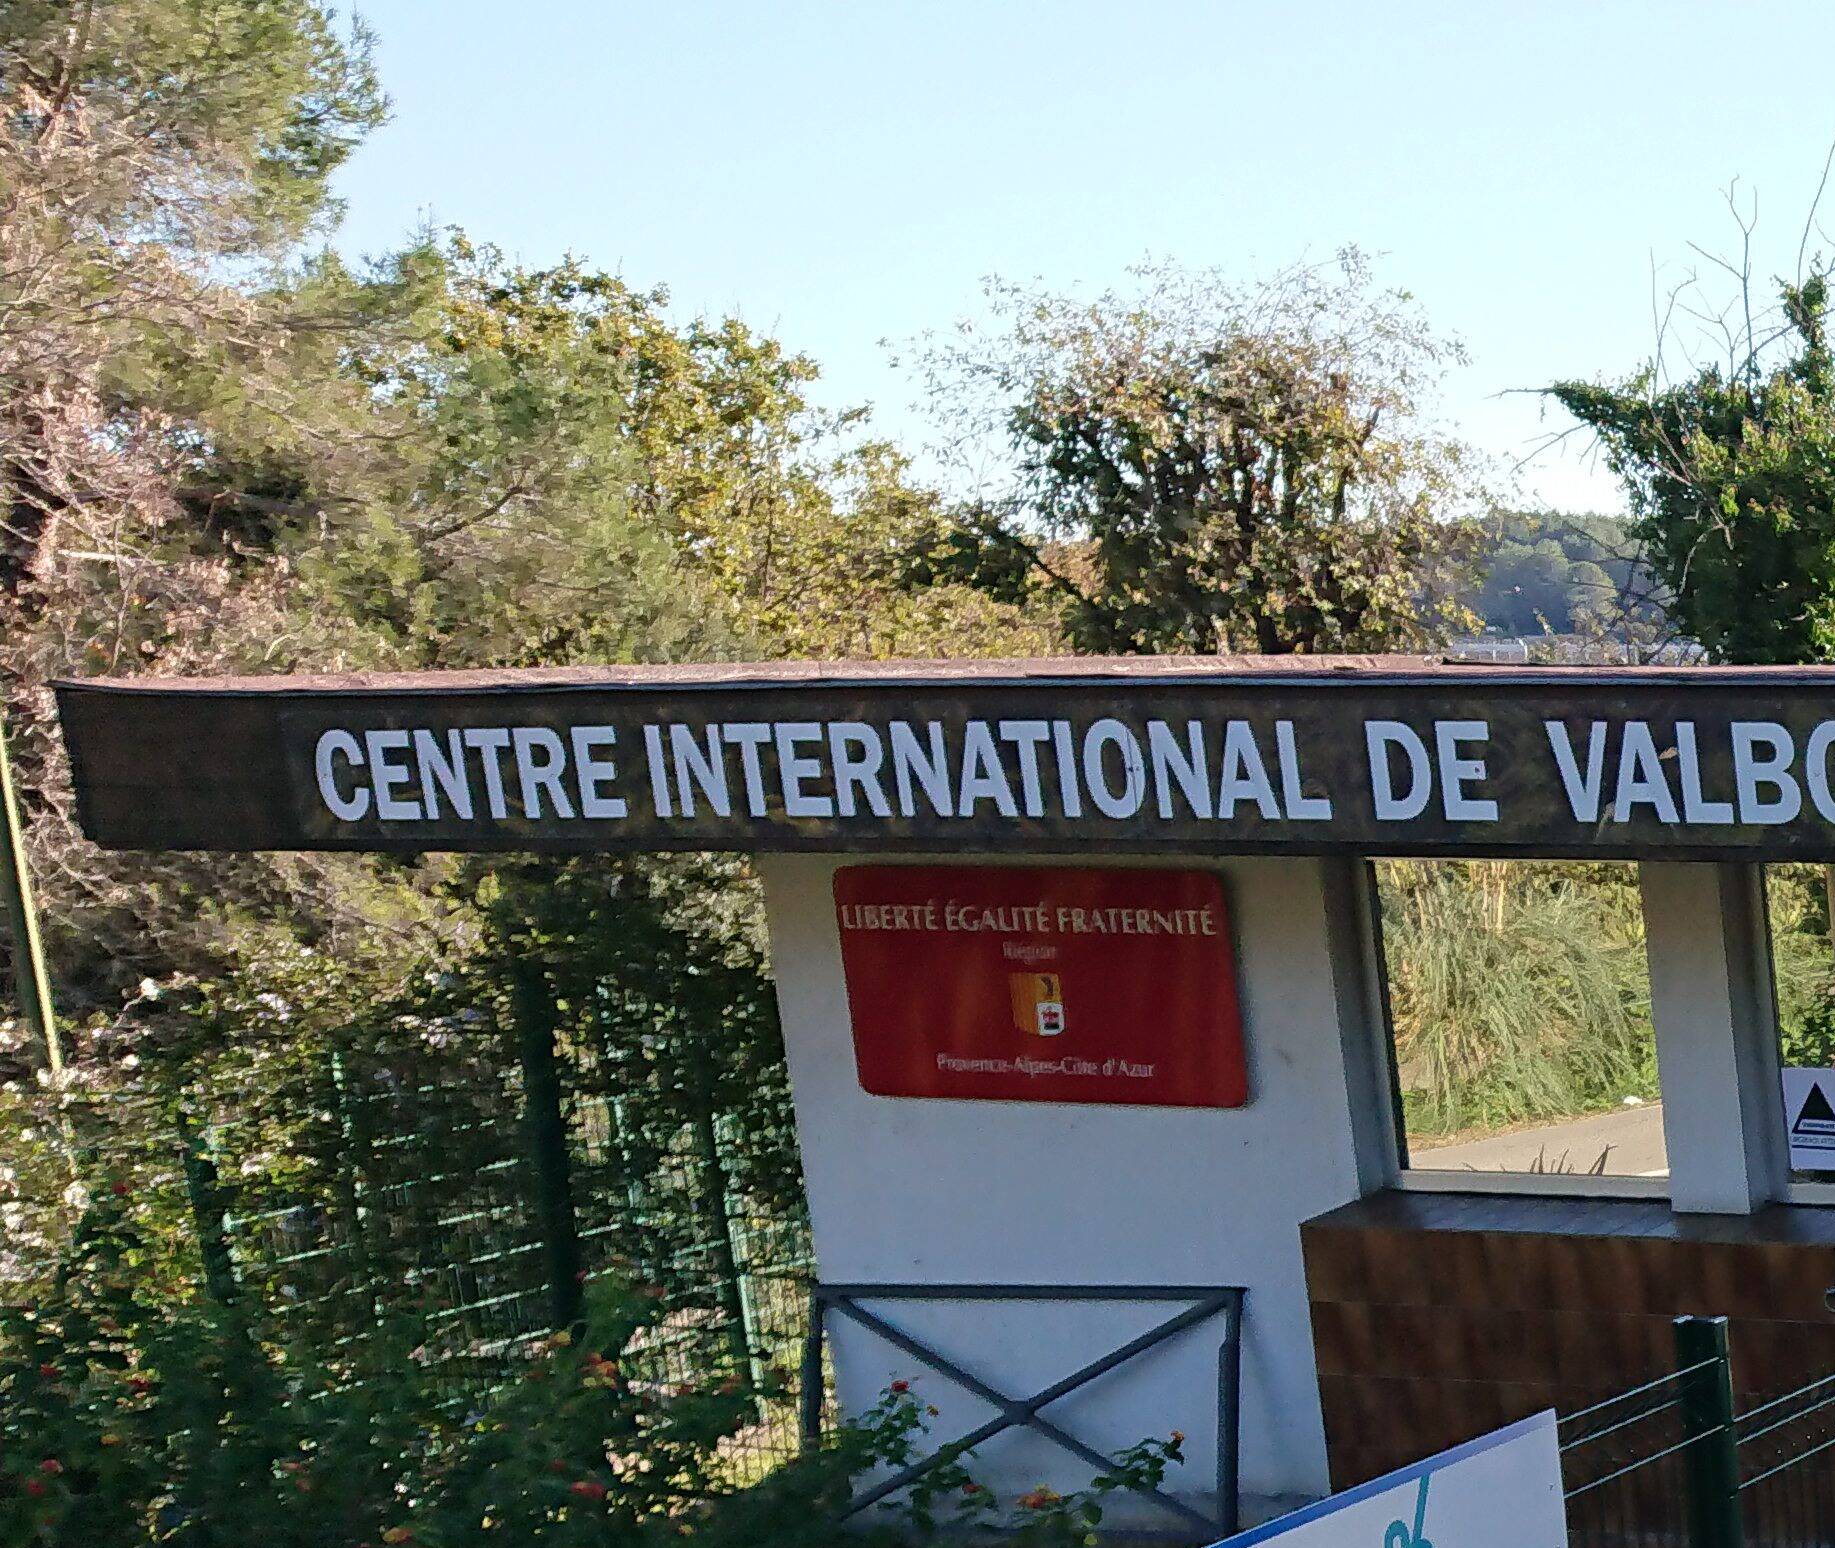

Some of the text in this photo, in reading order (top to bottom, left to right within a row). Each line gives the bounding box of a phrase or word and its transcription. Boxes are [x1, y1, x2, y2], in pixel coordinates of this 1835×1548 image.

[313, 724, 629, 823] CENTRE
[643, 718, 1333, 822] INTERNATIONAL
[1364, 718, 1500, 823] DE
[841, 898, 1217, 937] LIBERTÉ ÉGALITÉ FRATERNITÉ
